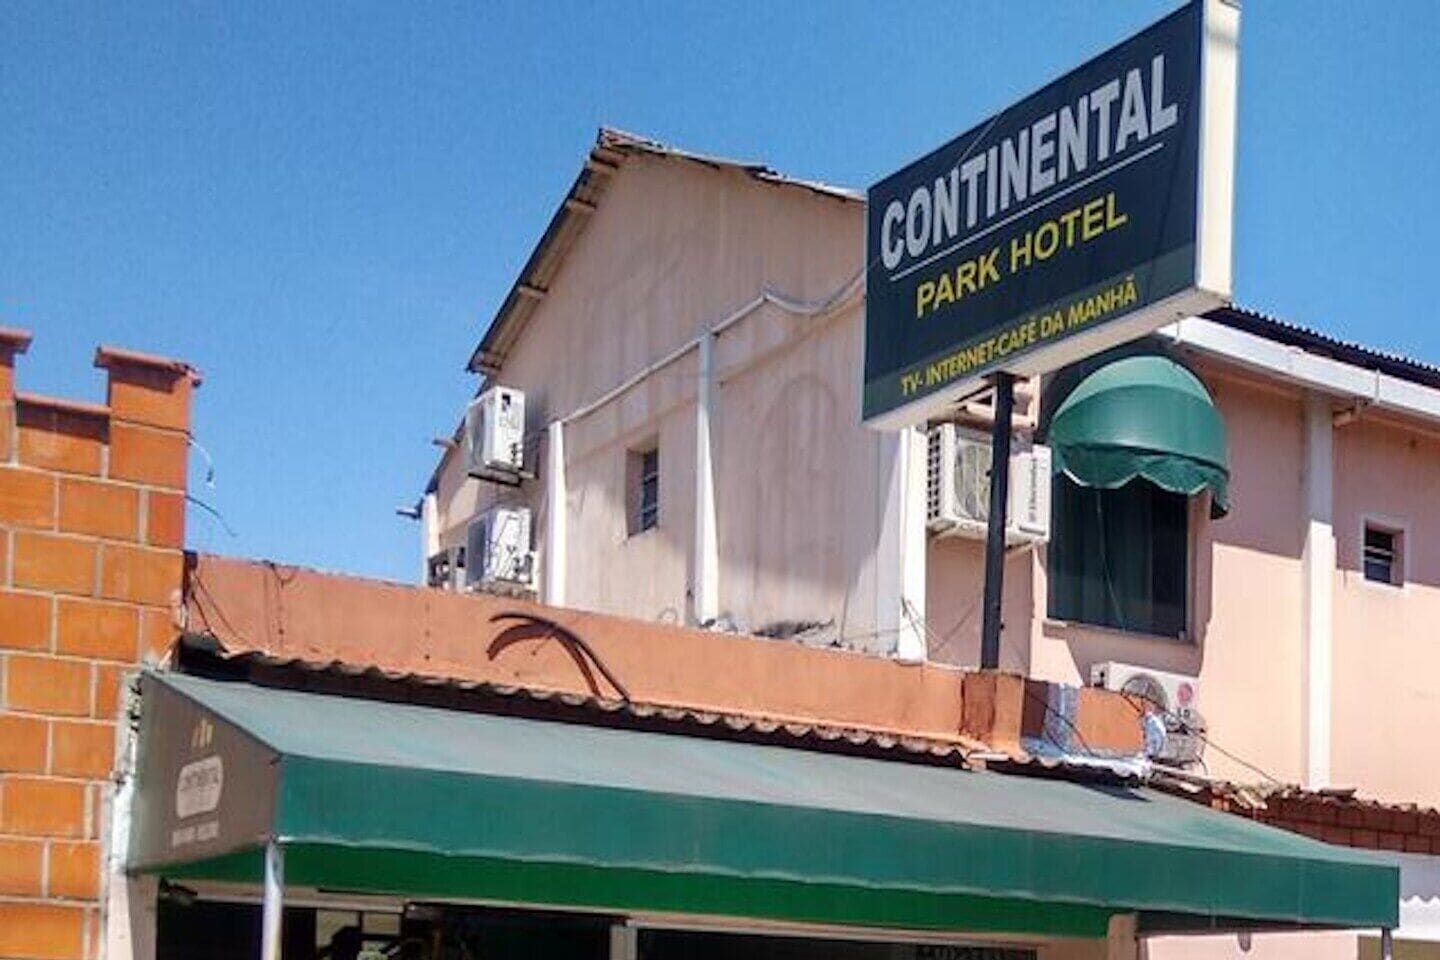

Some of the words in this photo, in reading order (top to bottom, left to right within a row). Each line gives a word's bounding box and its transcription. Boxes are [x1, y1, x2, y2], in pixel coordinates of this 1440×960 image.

[880, 53, 1178, 271] CONTINENTAL
[916, 248, 1001, 319] PARK
[1010, 191, 1128, 274] HOTEL
[1041, 310, 1064, 338] DA
[1068, 273, 1138, 330] MANHÃ
